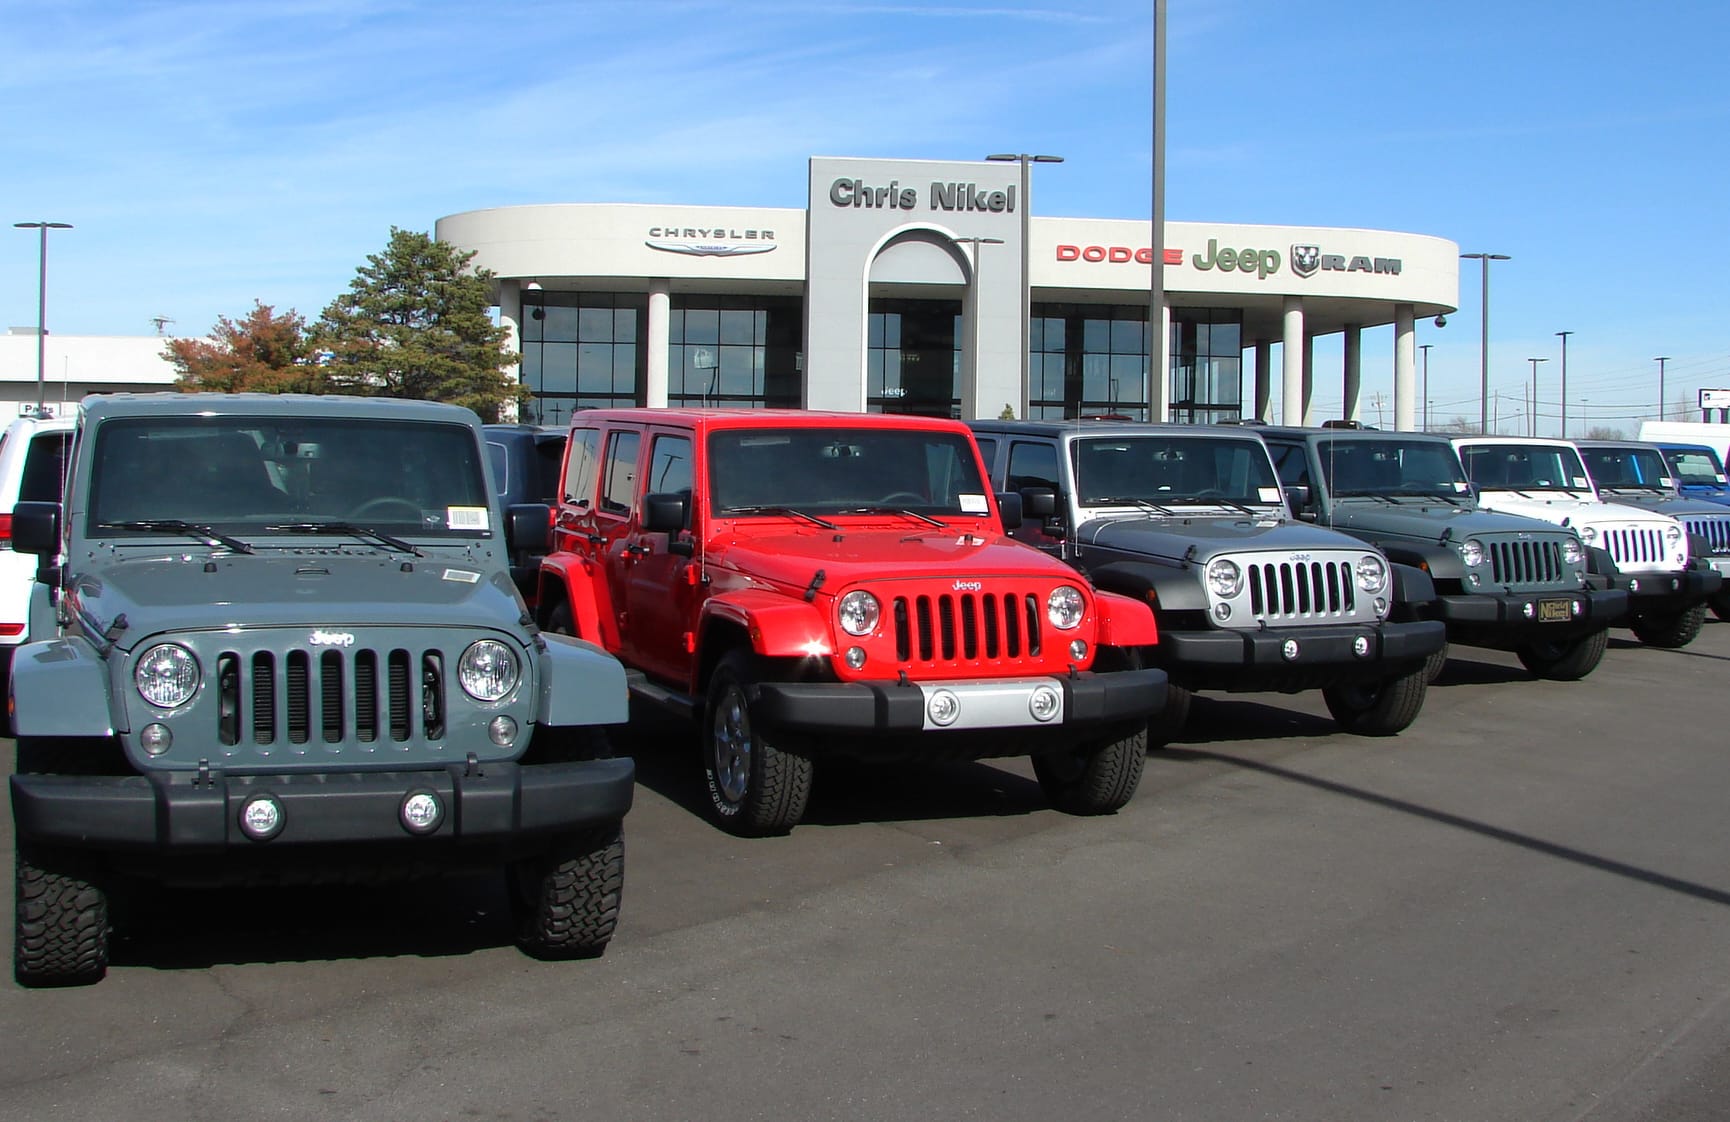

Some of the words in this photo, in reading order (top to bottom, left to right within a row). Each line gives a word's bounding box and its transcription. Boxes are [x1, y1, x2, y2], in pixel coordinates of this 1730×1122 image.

[830, 178, 917, 210] Chris
[930, 182, 1016, 213] Nikel
[648, 227, 775, 240] CHRYSLER
[1056, 245, 1184, 265] DODGE
[1192, 239, 1281, 280] Jeep
[1321, 254, 1402, 275] RAM
[25, 404, 54, 414] Pats
[952, 579, 982, 592] Jeep
[309, 630, 355, 648] Jeep
